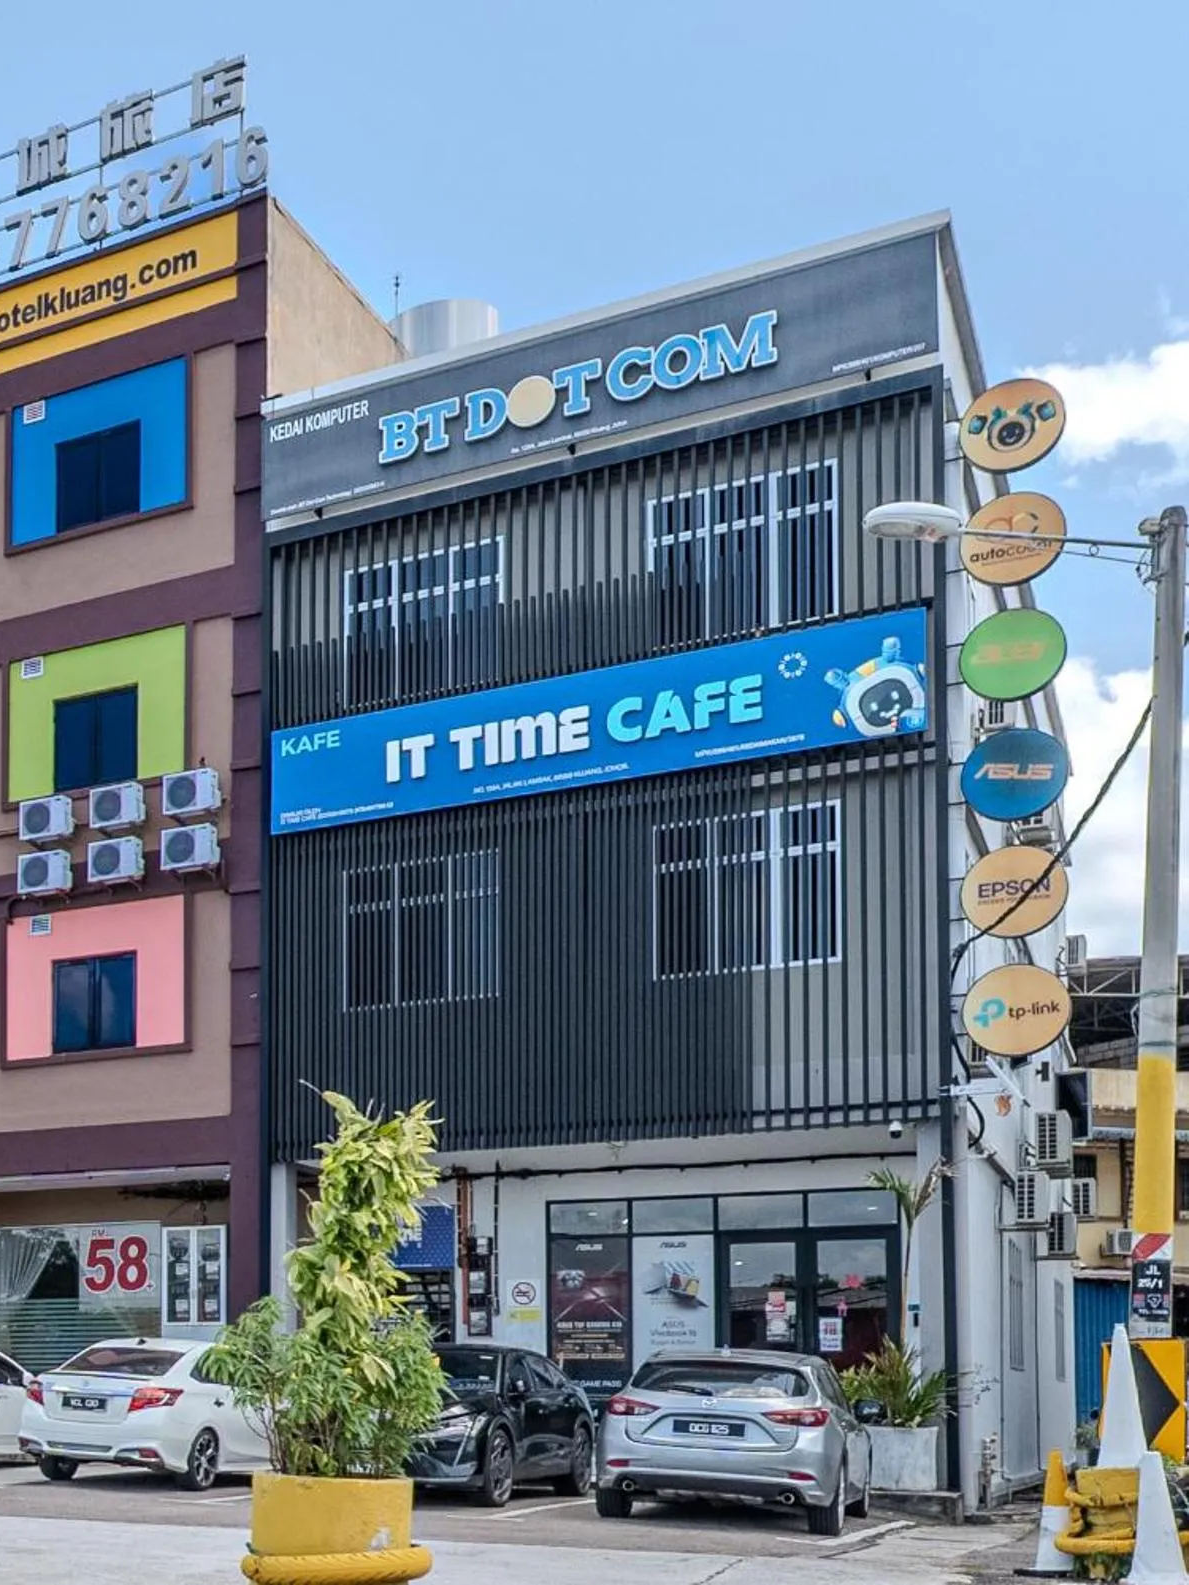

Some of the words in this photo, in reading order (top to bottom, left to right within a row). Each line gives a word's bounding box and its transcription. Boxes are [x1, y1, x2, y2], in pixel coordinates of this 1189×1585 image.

[269, 418, 304, 443] KEDAI
[305, 400, 370, 433] KOMPUTER
[385, 733, 435, 784] IT
[450, 704, 591, 771] TIME
[606, 673, 764, 743] CAFE
[280, 729, 341, 757] KAFE
[972, 762, 1056, 781] ASUS
[977, 877, 1051, 899] EPSON
[1008, 1000, 1061, 1021] tp-link
[575, 1243, 603, 1251] ASUS
